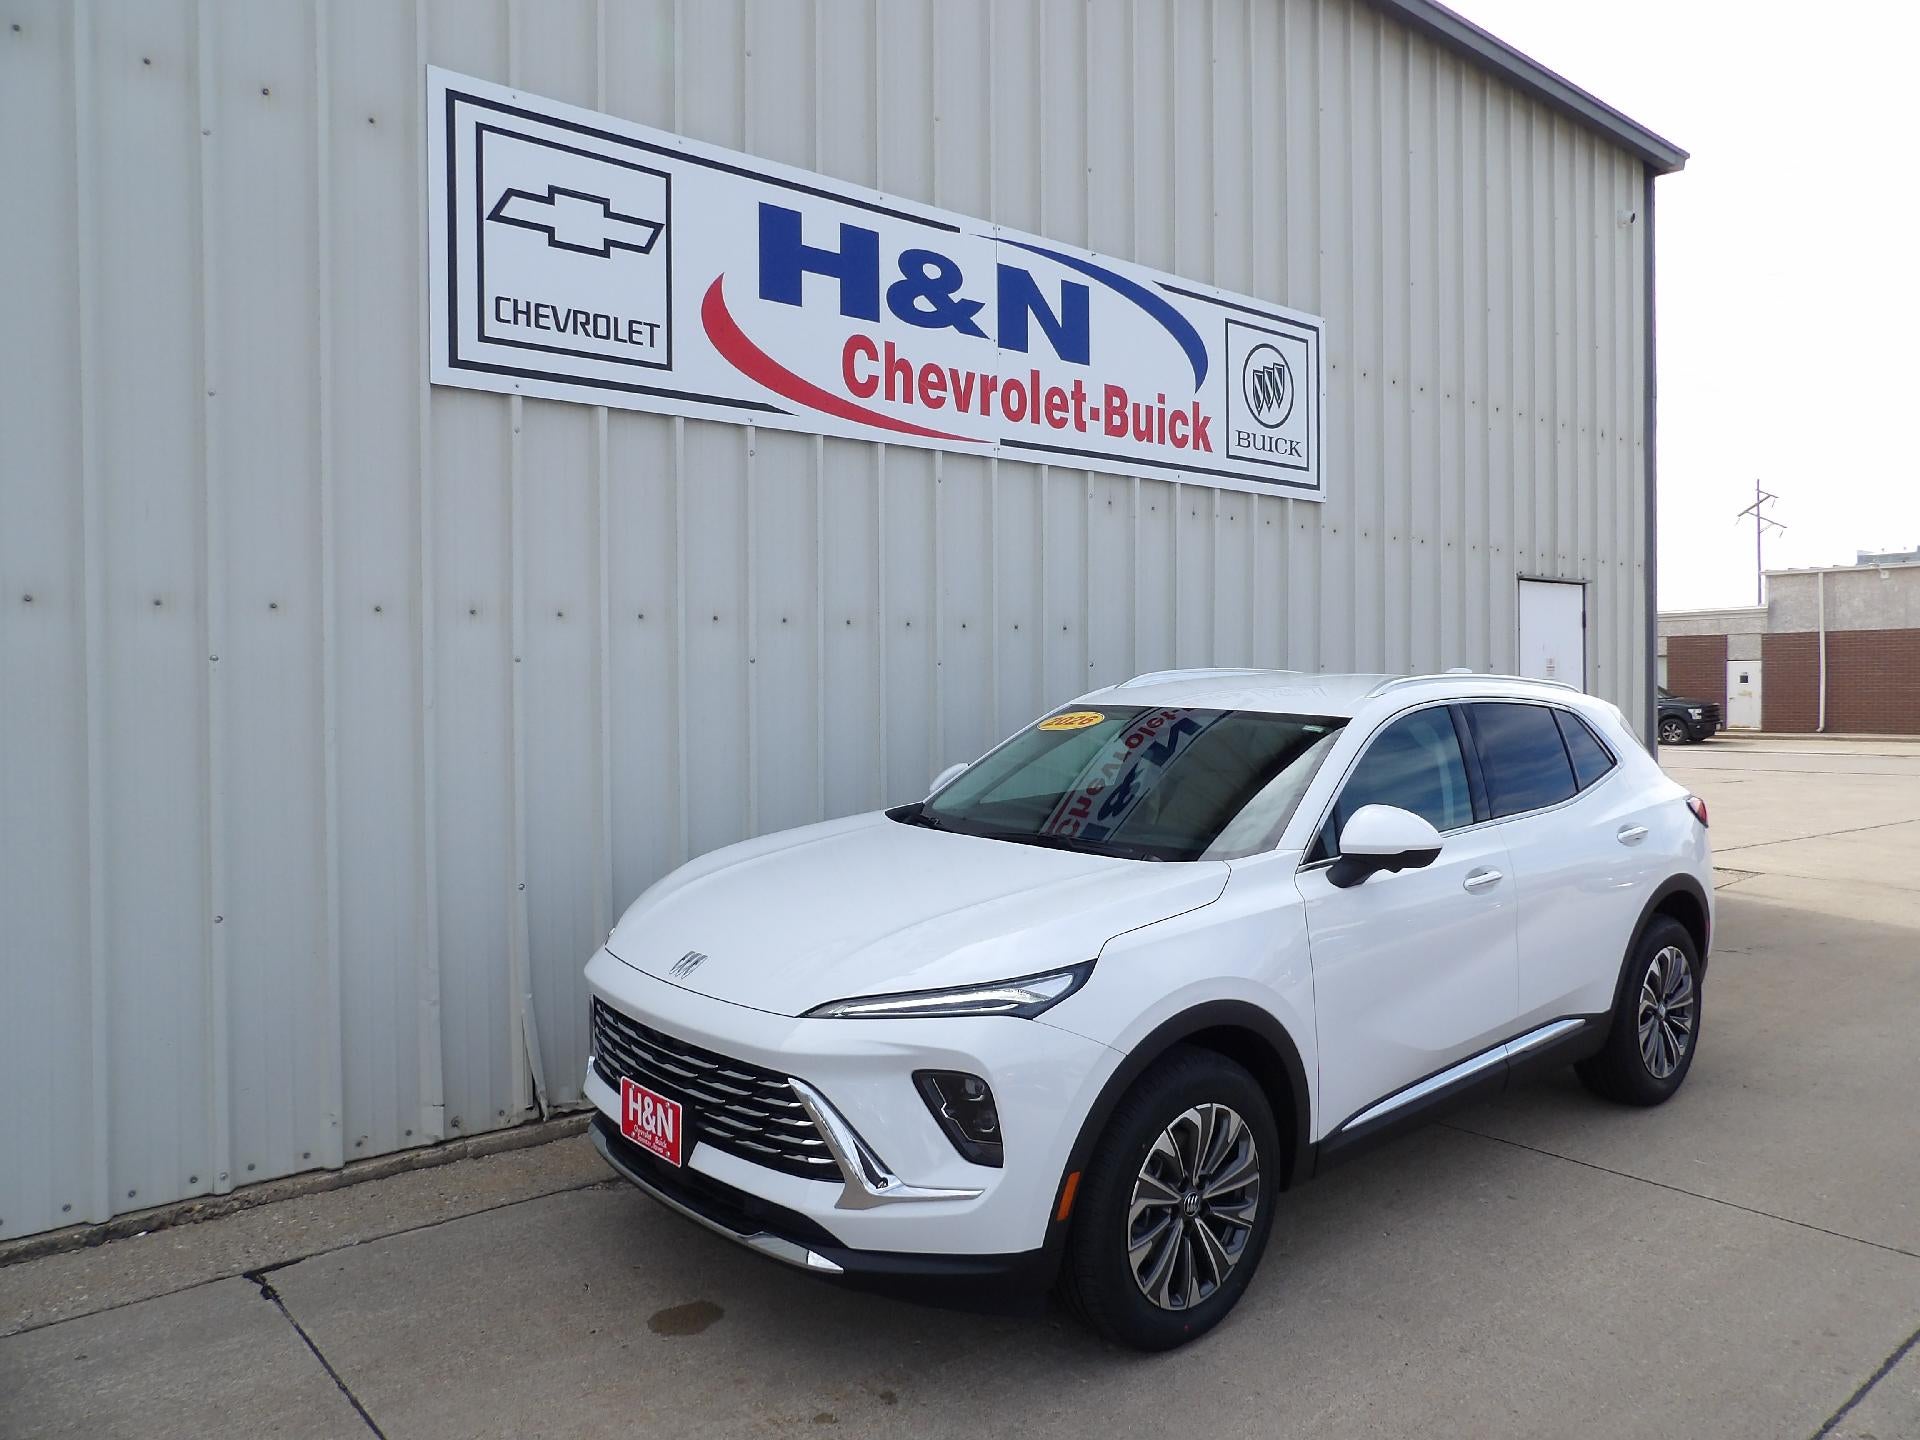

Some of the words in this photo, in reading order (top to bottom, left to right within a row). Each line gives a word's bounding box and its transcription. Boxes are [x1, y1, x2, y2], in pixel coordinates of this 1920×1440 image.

[759, 202, 1091, 367] H&N
[495, 295, 661, 348] CHEVROLET
[842, 334, 1213, 453] Chevrolet-Buick
[1235, 429, 1302, 458] BUICK
[628, 1087, 674, 1143] H&N
